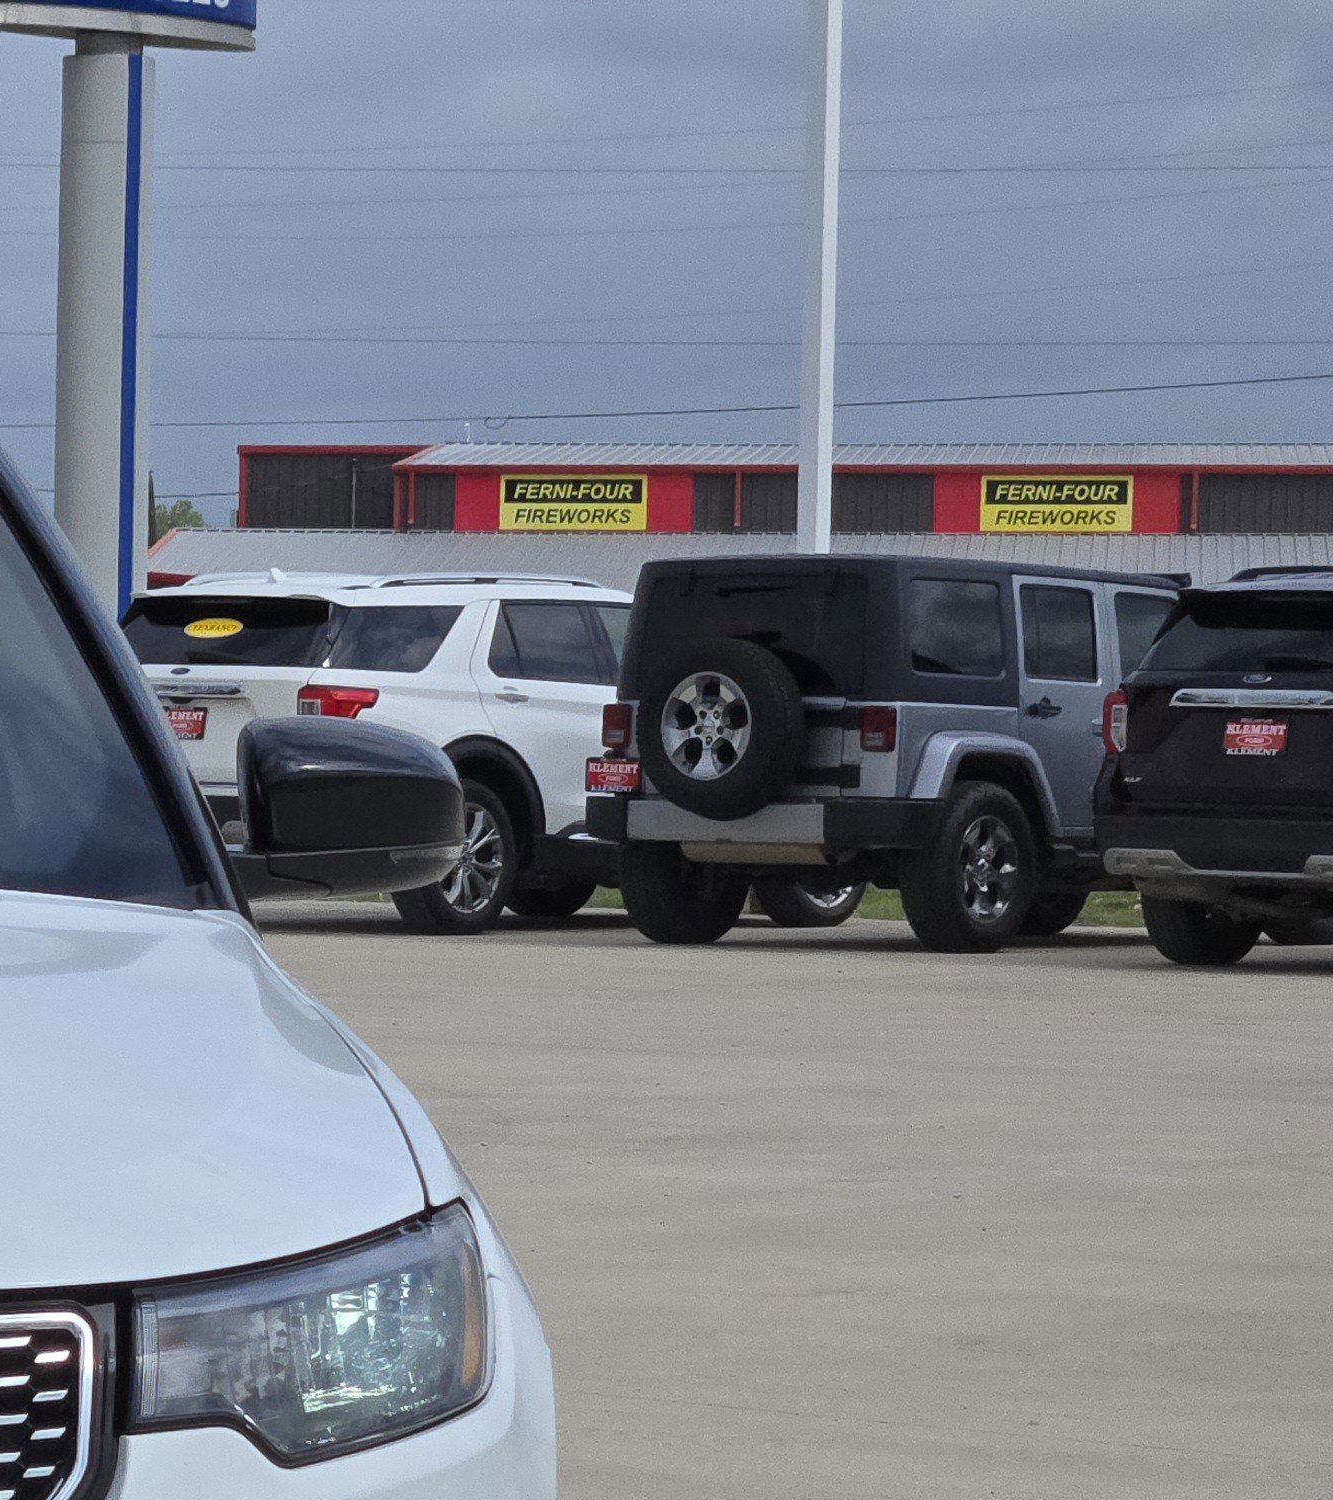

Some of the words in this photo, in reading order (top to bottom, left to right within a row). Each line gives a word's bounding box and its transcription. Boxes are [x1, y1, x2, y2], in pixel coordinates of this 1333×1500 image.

[514, 484, 633, 499] FERNI-FOUR
[995, 484, 1119, 500] FERNI-FOUR
[514, 508, 632, 524] FIREWORKS
[995, 509, 1117, 526] FIREWORKS
[167, 710, 204, 721] EMENT
[1226, 724, 1286, 735] KLEMENT
[589, 762, 639, 774] KLEMENT
